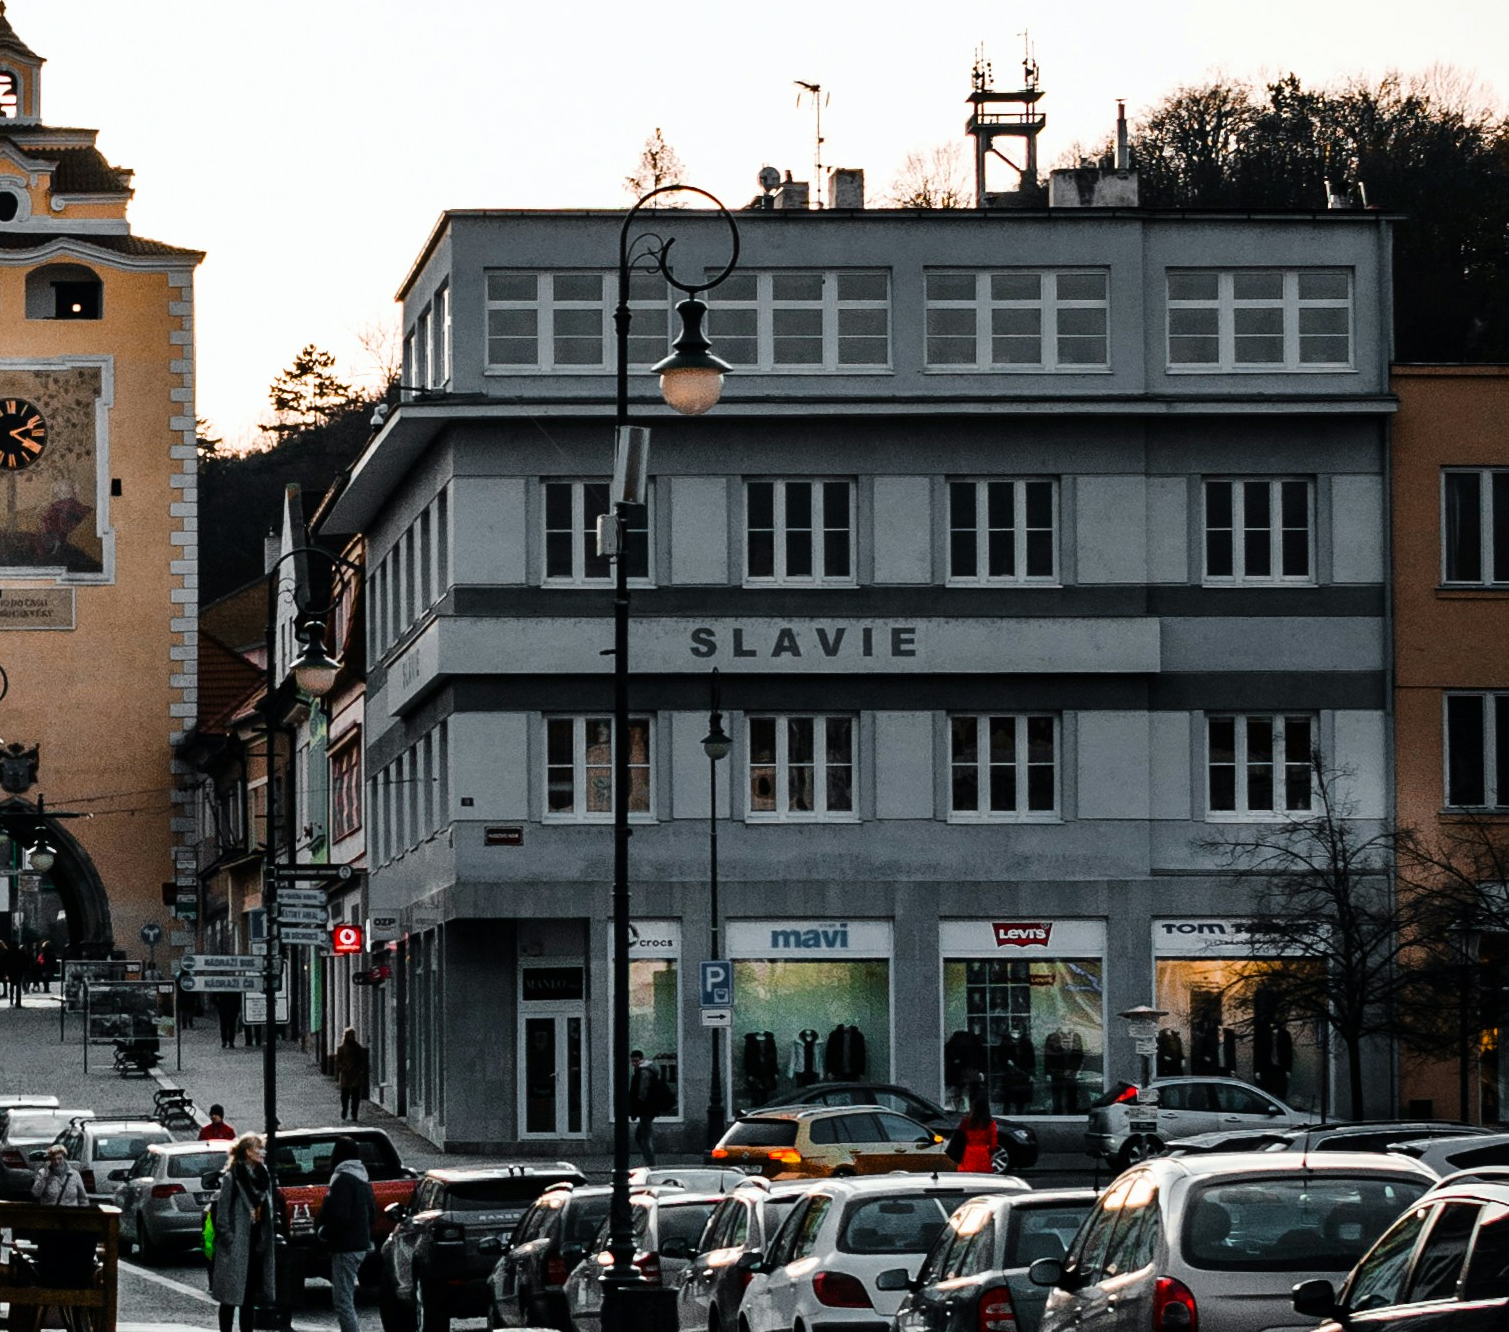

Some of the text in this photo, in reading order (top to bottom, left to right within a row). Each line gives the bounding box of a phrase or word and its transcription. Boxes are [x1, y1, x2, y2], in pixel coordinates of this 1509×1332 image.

[690, 627, 916, 658] SLAVIE
[374, 917, 396, 927] OZP
[1161, 923, 1227, 934] TOM
[639, 939, 674, 947] crocs
[771, 923, 848, 948] mavi
[706, 966, 726, 993] P
